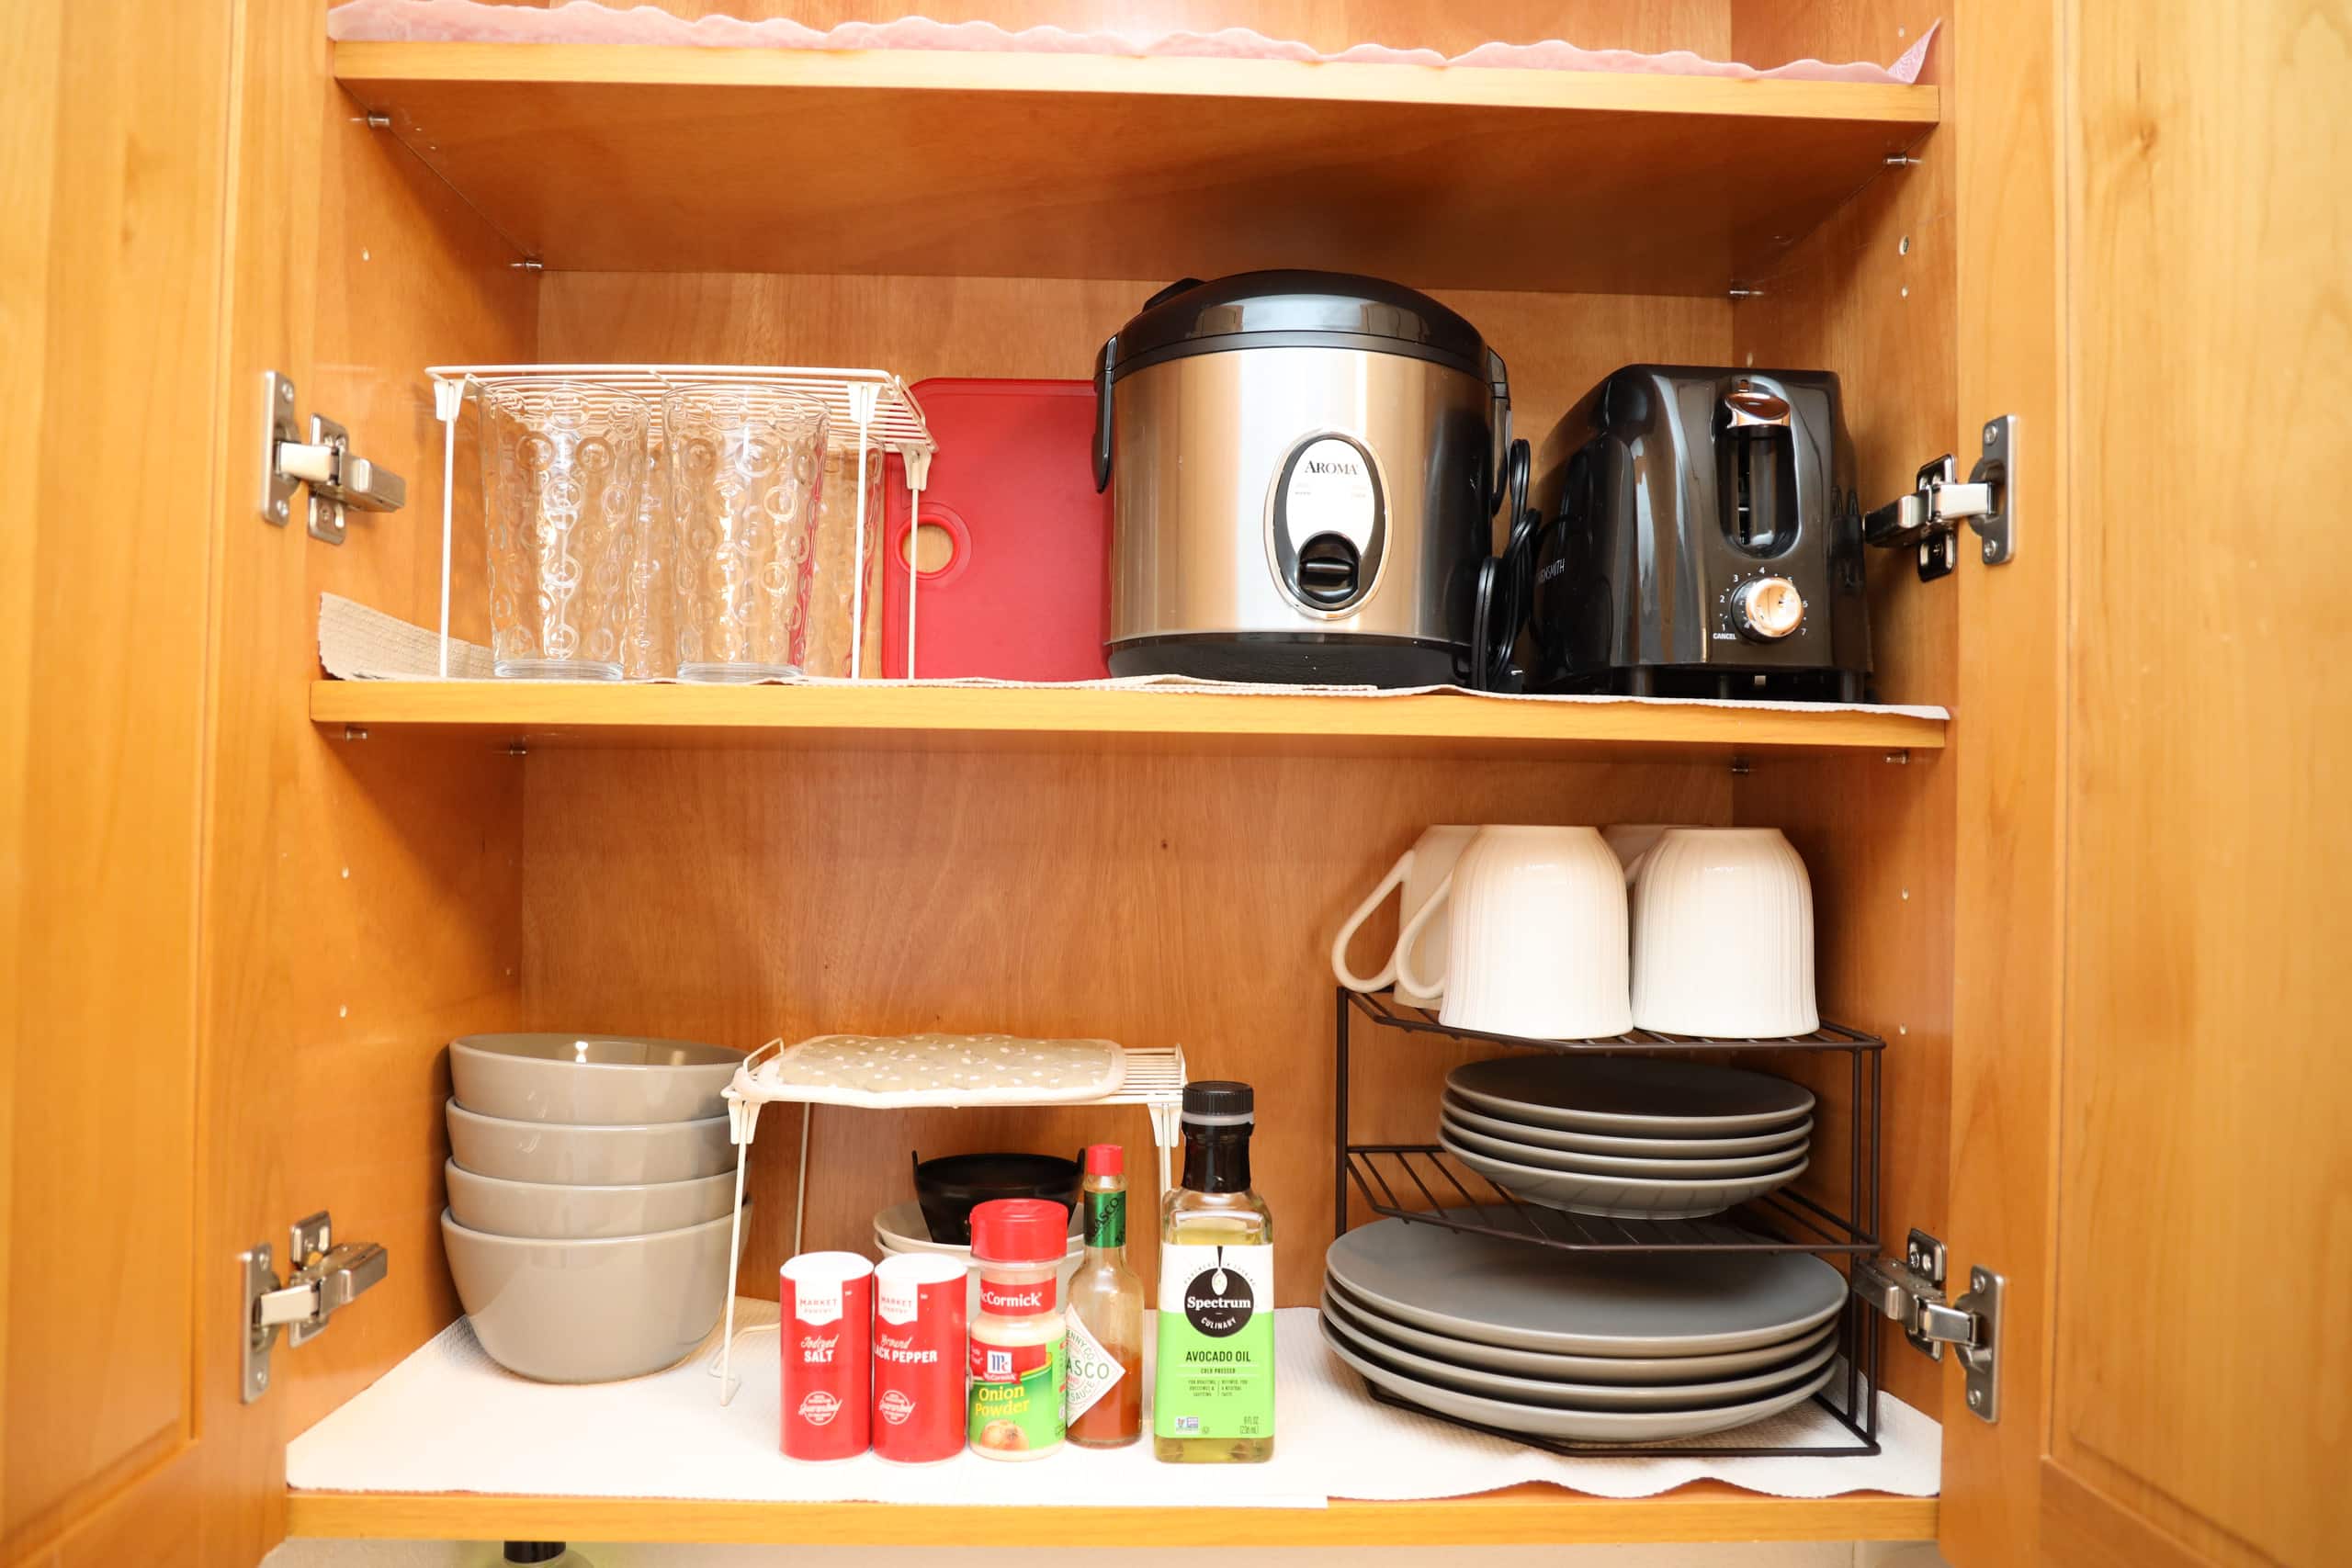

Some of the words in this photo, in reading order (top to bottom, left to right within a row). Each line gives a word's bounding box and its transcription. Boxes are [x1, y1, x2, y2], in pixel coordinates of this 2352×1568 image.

[1305, 460, 1358, 475] AROMA
[1734, 574, 1739, 582] 3
[1801, 627, 1807, 636] 7
[1186, 1296, 1250, 1311] Spectrum
[1201, 1316, 1236, 1330] CULINARY
[804, 1350, 834, 1363] SALT
[874, 1344, 890, 1359] ACK
[892, 1350, 938, 1364] PEPPER
[1185, 1351, 1232, 1362] AVOCADO
[1235, 1351, 1251, 1362] OIL
[978, 1385, 1024, 1402] Onion
[1070, 1381, 1096, 1402] SAUCE
[975, 1399, 1030, 1416] Powder
